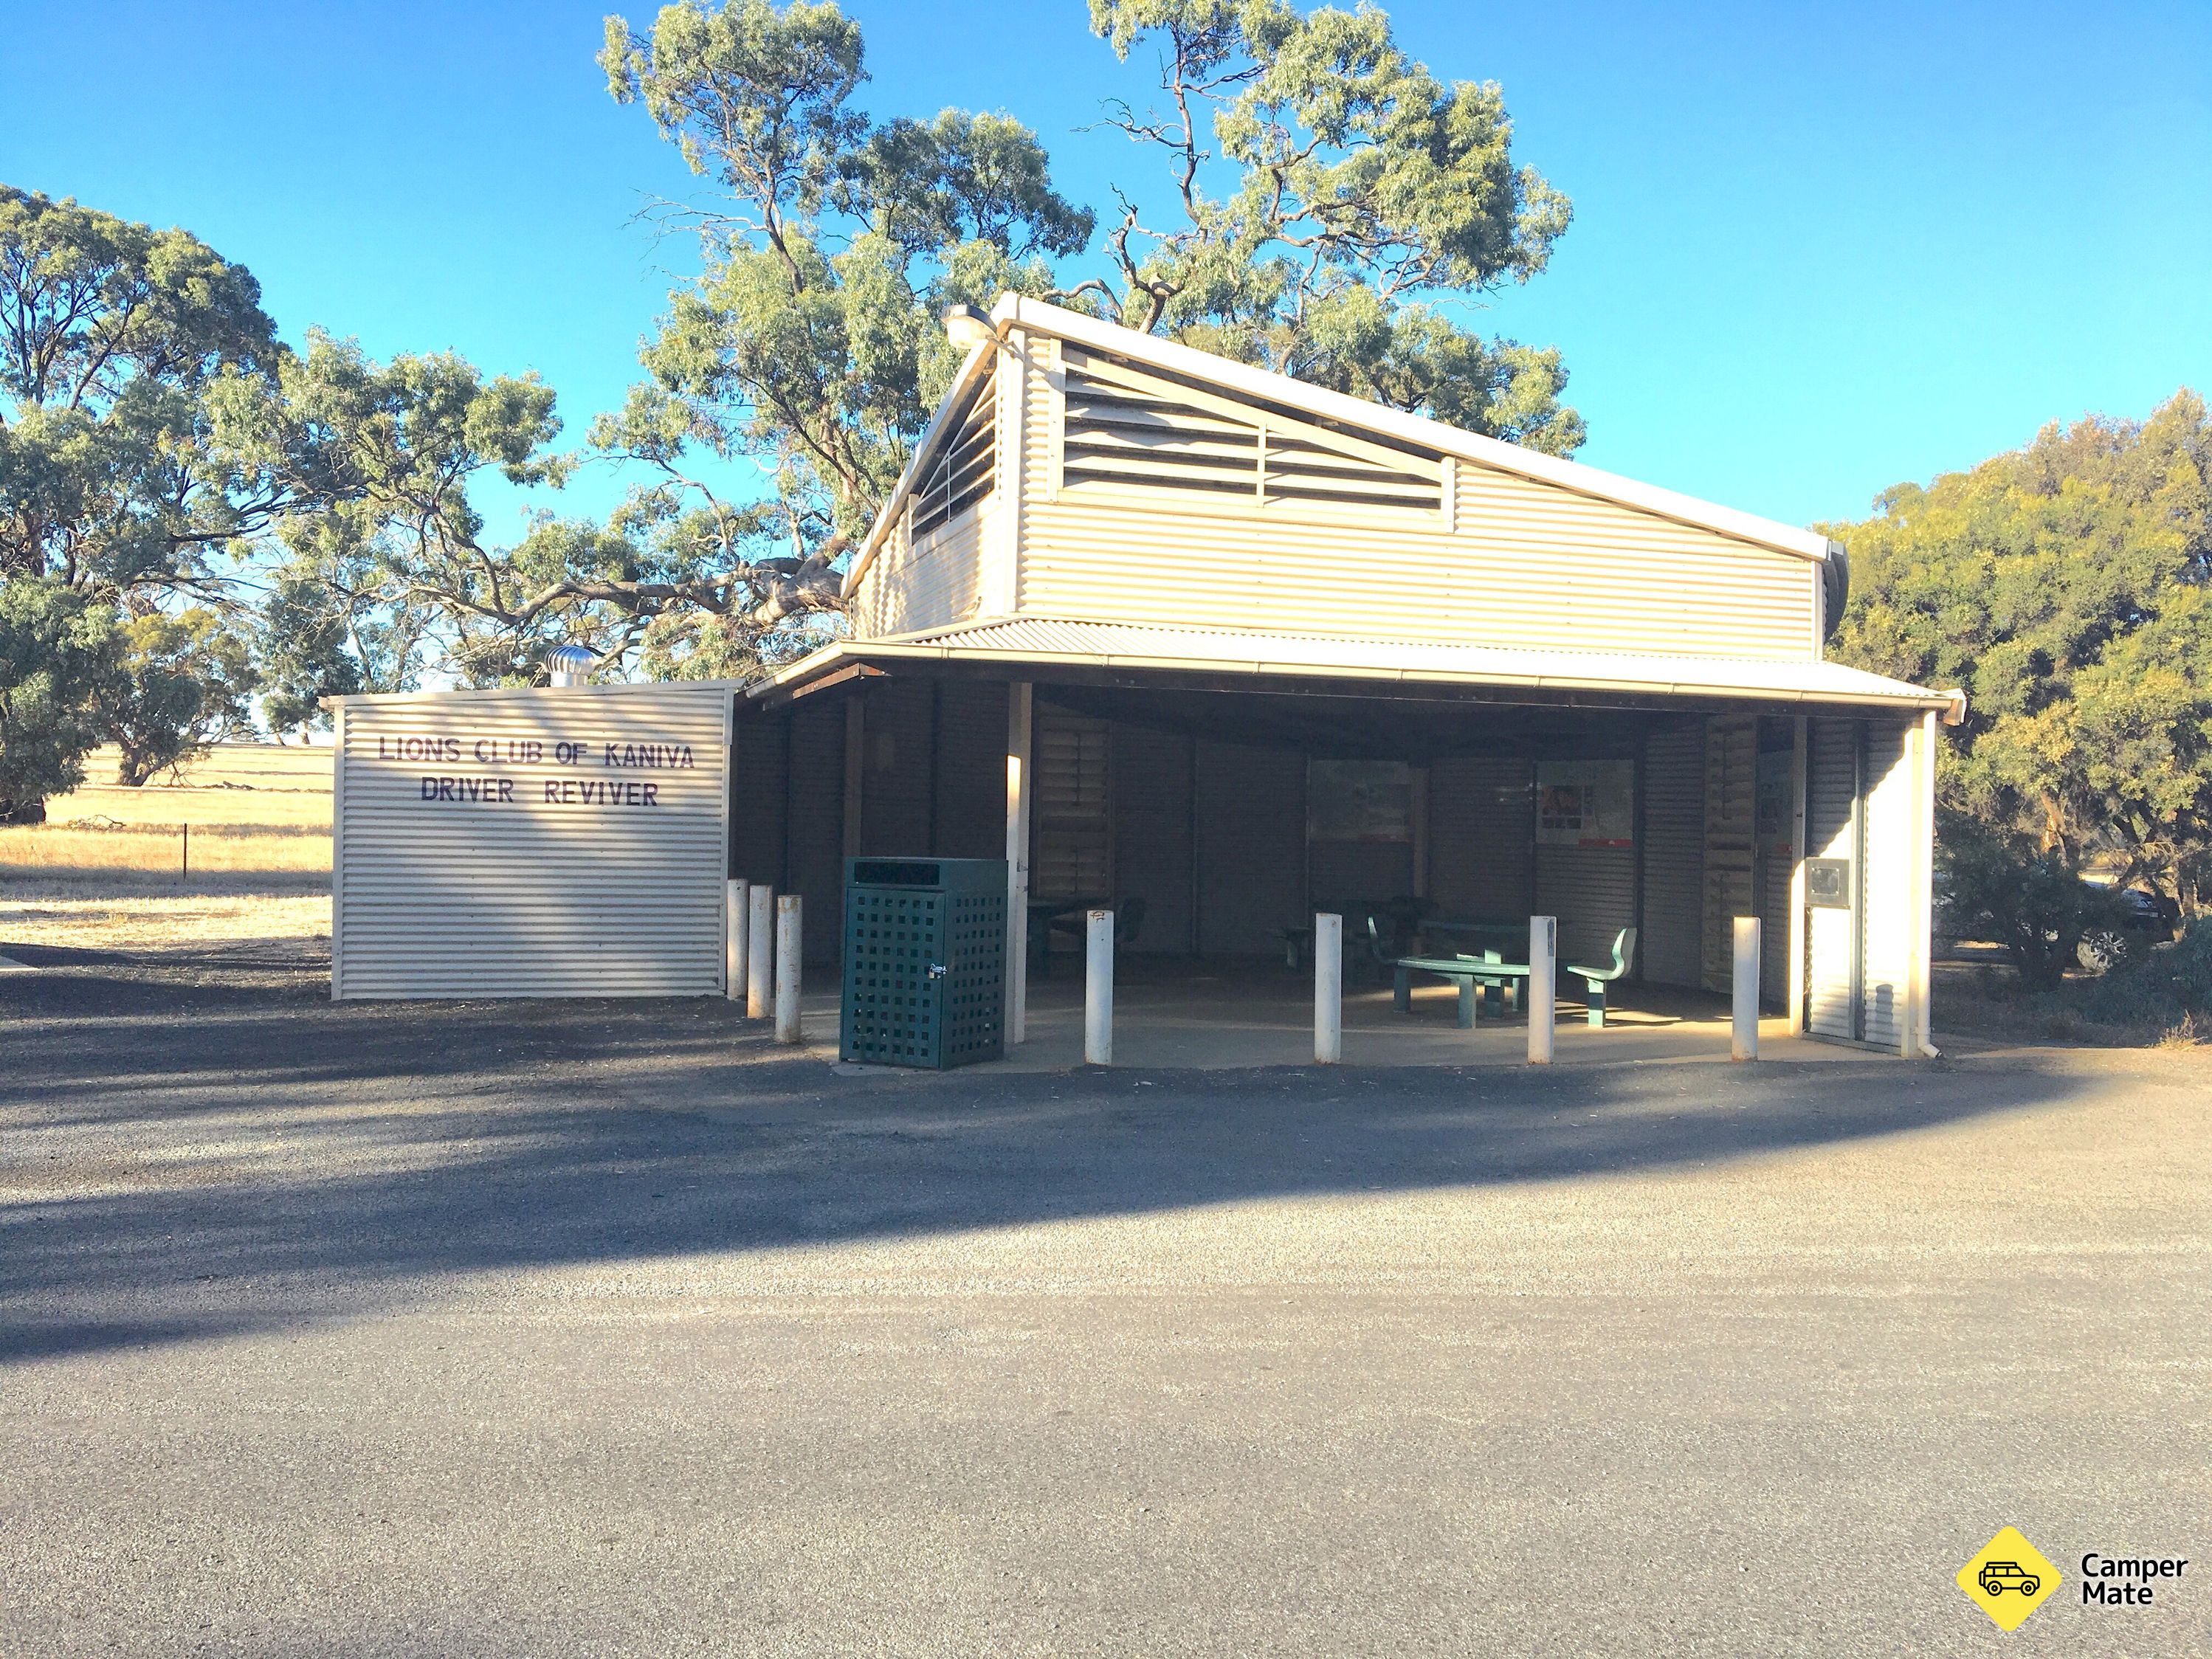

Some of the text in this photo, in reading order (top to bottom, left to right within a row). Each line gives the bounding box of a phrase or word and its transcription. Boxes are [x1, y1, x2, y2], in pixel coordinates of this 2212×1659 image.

[379, 737, 695, 768] LIONS CLUB OF KANIVA
[421, 777, 658, 807] DRIVER REVIVER
